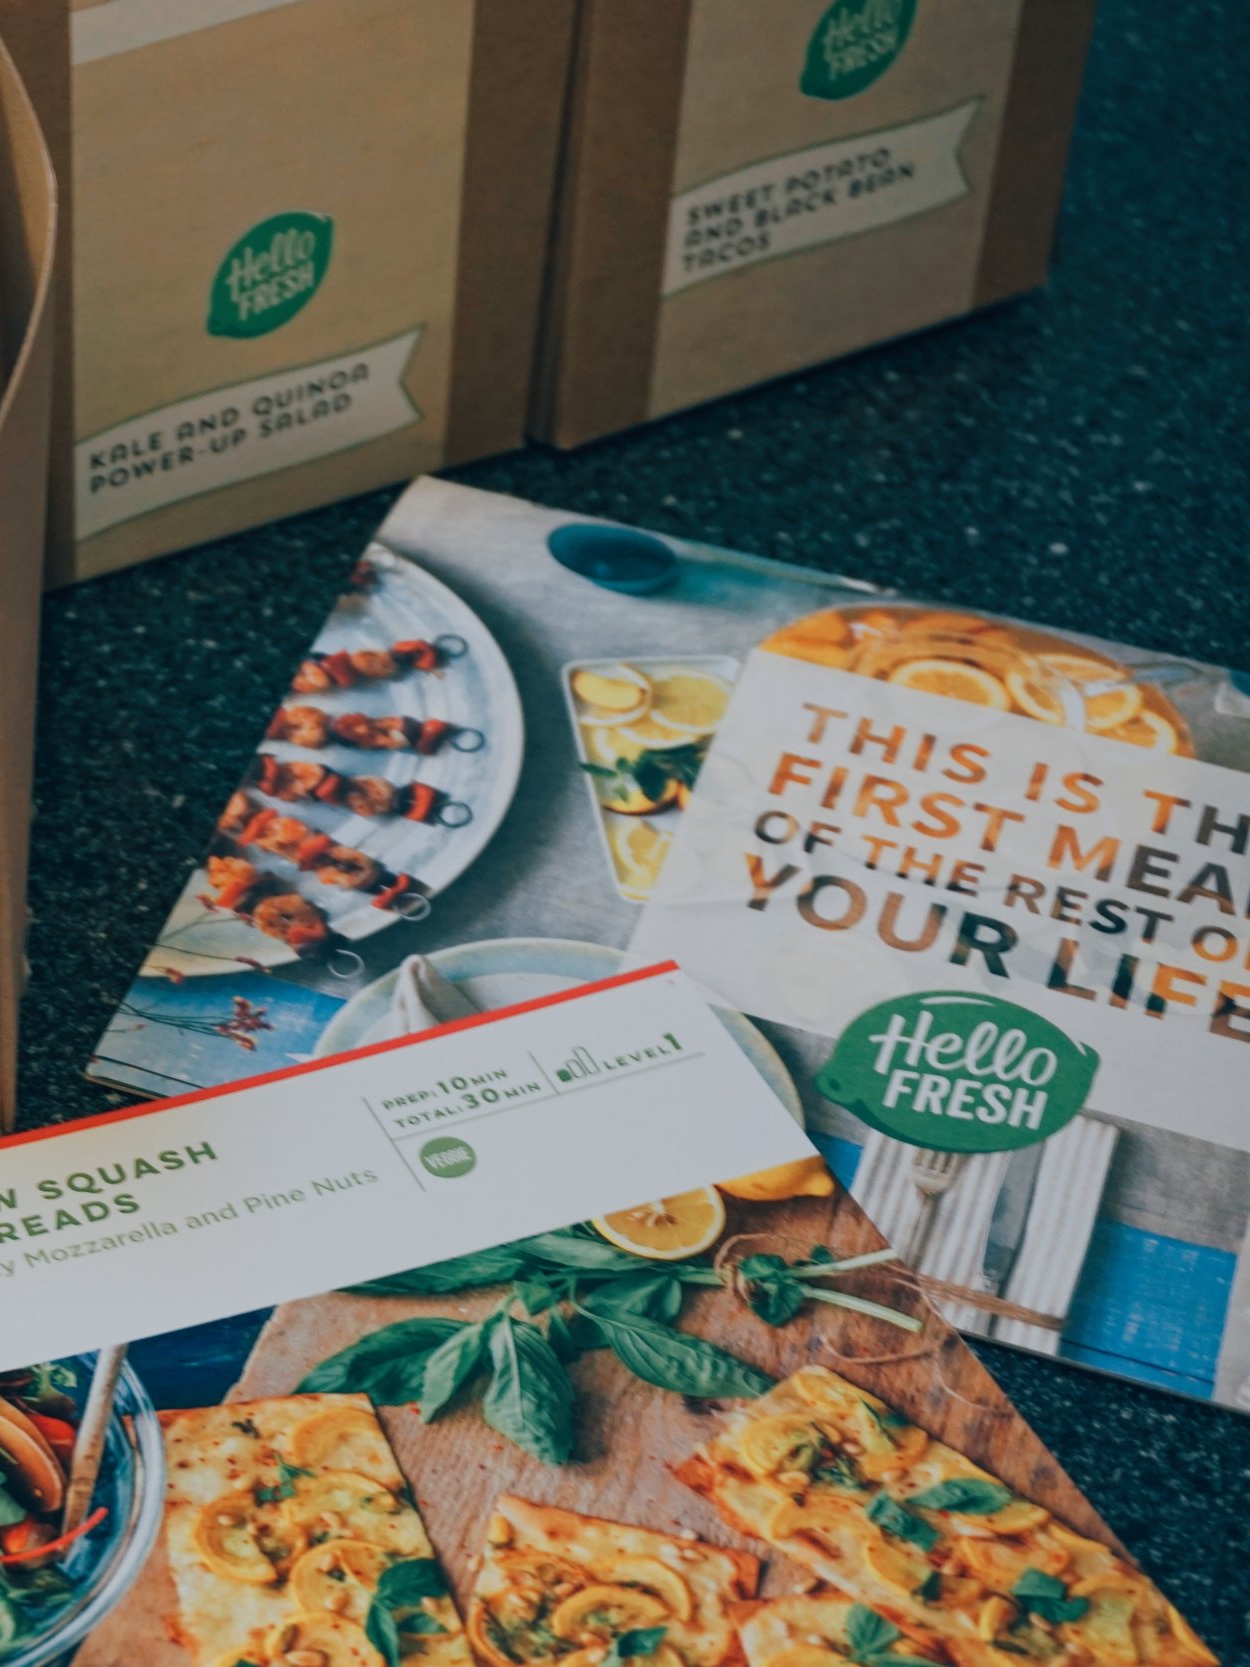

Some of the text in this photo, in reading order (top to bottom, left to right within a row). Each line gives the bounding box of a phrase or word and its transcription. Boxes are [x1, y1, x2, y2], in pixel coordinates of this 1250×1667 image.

[685, 160, 916, 247] AND BLACK BEAN
[688, 146, 890, 226] SWEET POTATO
[225, 228, 317, 303] Hello
[237, 260, 315, 321] FRESH
[683, 231, 771, 272] TACOS
[89, 362, 370, 470] KALE AND QUINOA
[89, 393, 352, 494] POWER-UP SALAD
[803, 702, 991, 785] THIS
[1025, 762, 1105, 815] IS
[768, 752, 1250, 922] FIRST MEA
[754, 810, 1250, 971] OF THE REST O
[745, 852, 1250, 1043] YOUR LIFE
[869, 1010, 1058, 1086] Hello
[883, 1070, 1048, 1130] FRESH
[37, 1141, 218, 1201] SQUASH
[423, 1145, 473, 1171] VEGGIE
[23, 1221, 179, 1269] Mozzarella
[187, 1202, 239, 1230] and
[243, 1187, 306, 1215] Pine
[312, 1167, 379, 1196] Nuts
